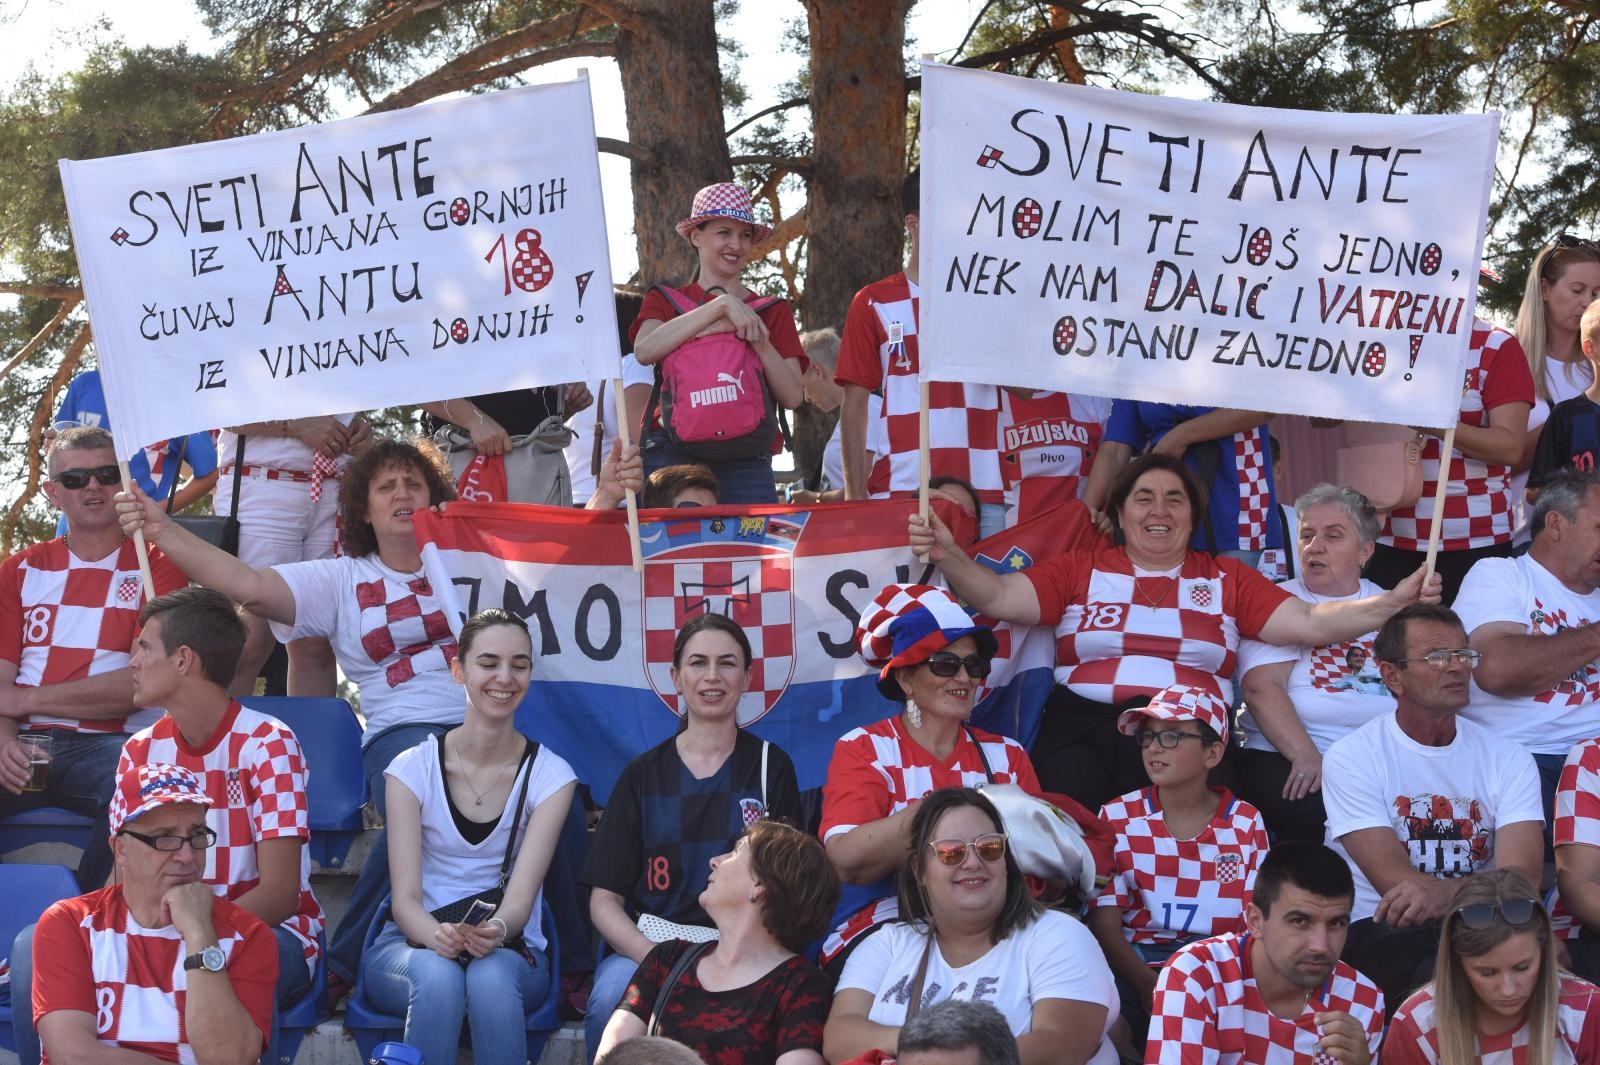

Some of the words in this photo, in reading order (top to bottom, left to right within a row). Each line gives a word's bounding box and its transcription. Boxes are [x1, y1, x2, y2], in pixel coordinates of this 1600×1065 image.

[998, 109, 1206, 194] SVETI
[1228, 130, 1422, 204] ANTE
[123, 174, 265, 246] SVETI
[290, 137, 435, 223] ANTE
[190, 247, 224, 277] IZ
[247, 212, 400, 262] VINJANA
[424, 178, 567, 231] GORNJIH
[966, 193, 1121, 247] MOLIM
[1147, 214, 1199, 257] TE
[1222, 223, 1300, 270] JOŠ
[1323, 233, 1460, 282] JEDNO,
[140, 298, 235, 340] ČUVAJ
[264, 262, 423, 325] ANTU
[485, 229, 555, 297] 18
[945, 252, 1022, 296] NEK
[1040, 263, 1118, 304] NAM
[1144, 260, 1272, 320] DALIĆ
[1289, 286, 1305, 324] I
[1318, 278, 1466, 335] VATRENI
[195, 360, 227, 392] IZ
[259, 328, 410, 379] VINJANA
[1053, 316, 1200, 361] OSTANU
[1212, 330, 1387, 378] ZAJEDNO
[690, 384, 738, 408] PUMA
[1005, 420, 1089, 450] Džujsko
[1083, 604, 1123, 629] 18
[647, 856, 670, 891] 18
[1162, 903, 1199, 932] 17
